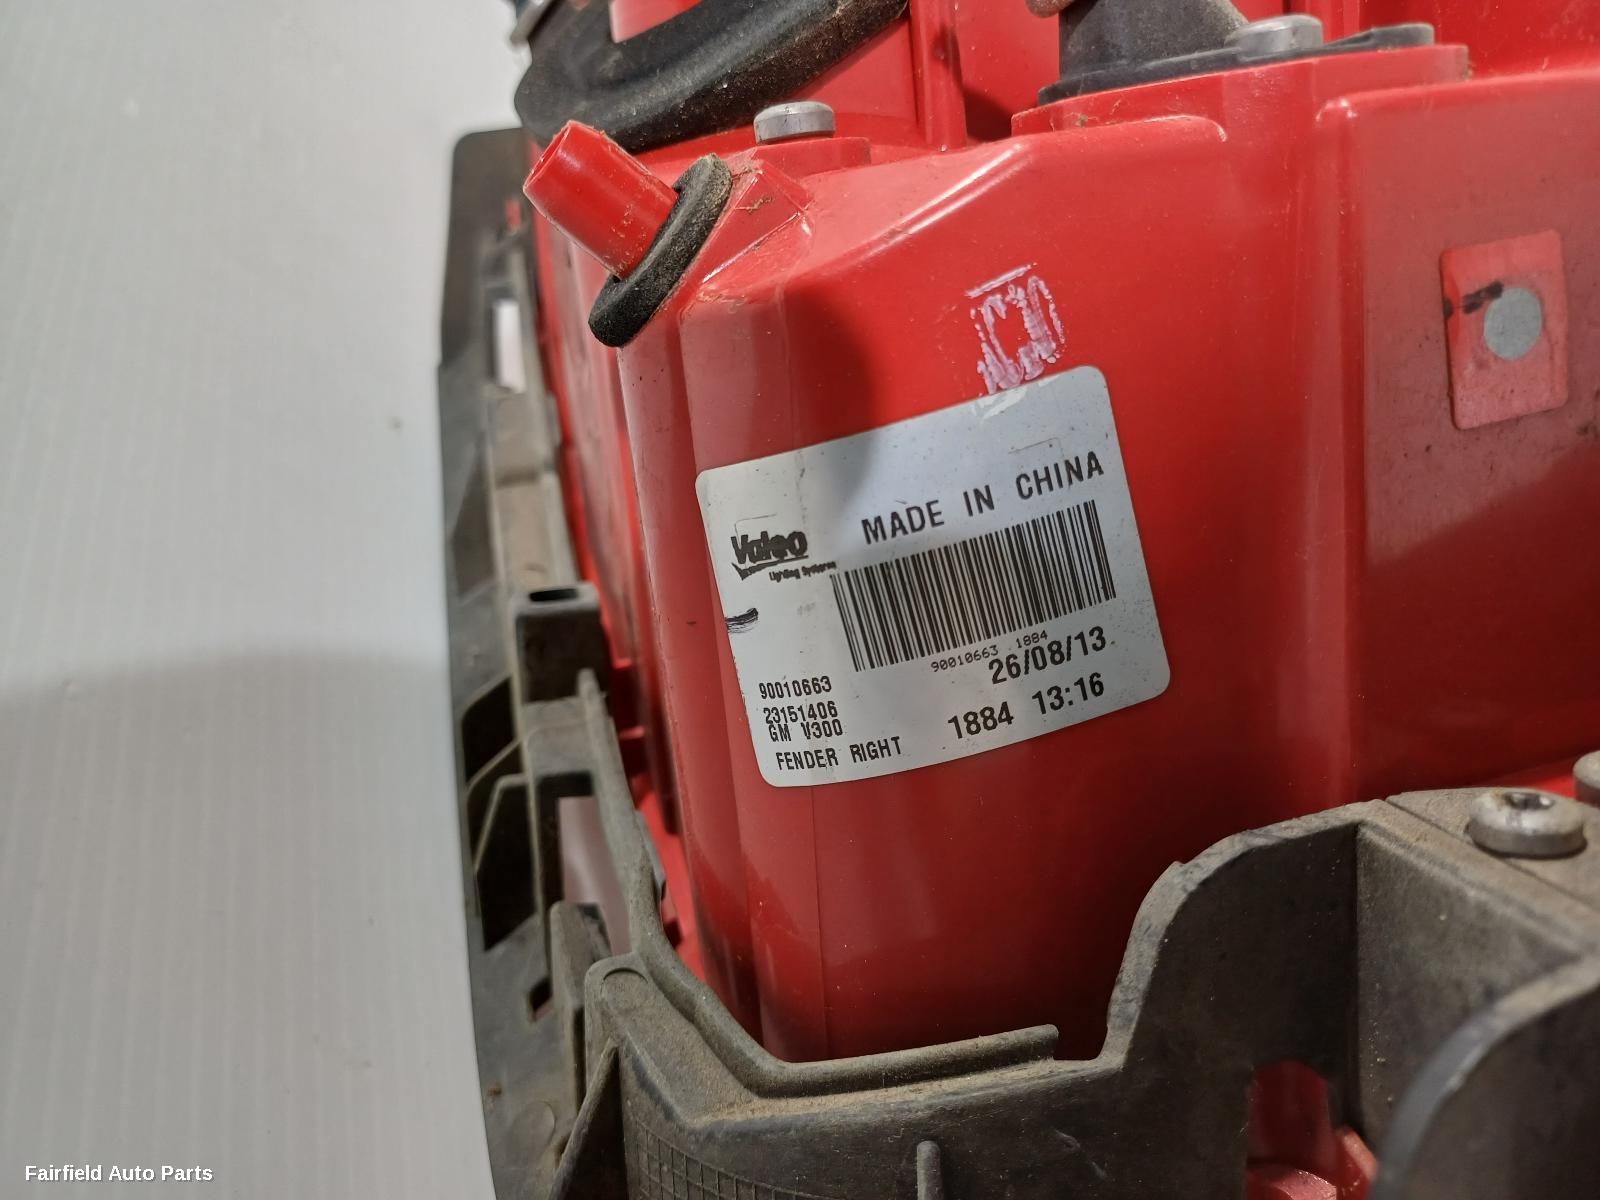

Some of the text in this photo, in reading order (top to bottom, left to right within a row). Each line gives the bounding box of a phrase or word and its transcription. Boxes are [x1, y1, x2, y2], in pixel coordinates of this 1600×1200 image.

[861, 451, 1104, 545] MADE IN CHINA
[731, 530, 808, 565] Valeo
[801, 561, 837, 577] Syst
[930, 630, 1048, 673] 90010663 1884
[988, 626, 1106, 685] 26/08/13
[759, 676, 832, 699] 90010663
[763, 701, 838, 725] 23151406
[948, 672, 1105, 739] 1884 13:16
[768, 718, 843, 742] GM V300
[776, 736, 901, 770] FENDER RIGHT
